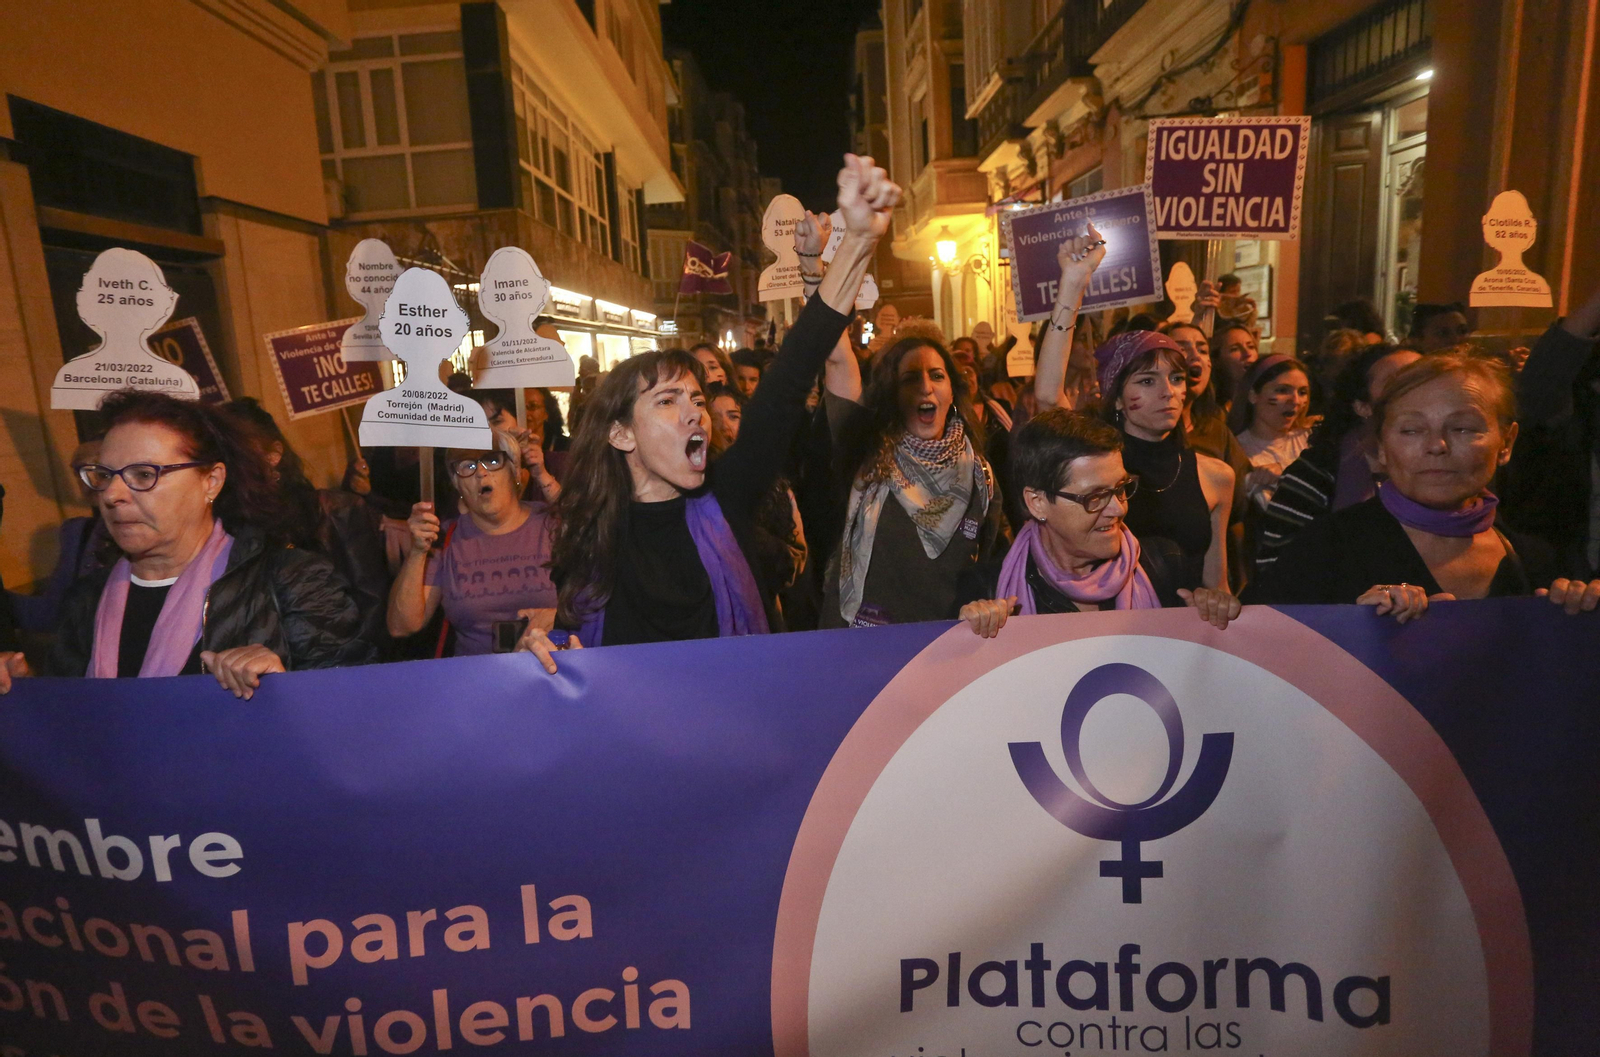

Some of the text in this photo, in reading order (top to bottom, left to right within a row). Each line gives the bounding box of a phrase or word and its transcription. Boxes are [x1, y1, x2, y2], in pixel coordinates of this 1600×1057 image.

[1160, 127, 1294, 161] IGUALDAD
[1201, 162, 1244, 194] SIN
[1054, 206, 1096, 223] Ante la
[1154, 196, 1285, 228] VIOLENCIA
[1489, 218, 1533, 228] Clotilde R.
[1019, 230, 1074, 246] Violencia
[1495, 230, 1528, 239] 82 años
[358, 262, 393, 271] Nombre
[98, 277, 153, 291] Iveth C.
[349, 273, 398, 283] no conocid
[494, 278, 529, 289] Imane
[361, 285, 371, 294] 44
[493, 291, 533, 302] 30 años
[1037, 281, 1058, 305] TE
[97, 294, 154, 307] 25 años
[398, 303, 448, 318] Esther
[305, 330, 337, 343] Ante la
[394, 322, 412, 336] 20
[415, 324, 453, 338] años
[501, 338, 538, 347] 01/11/2022
[280, 345, 322, 360] Violencia
[324, 342, 335, 351] de
[491, 349, 515, 357] Valencia
[524, 345, 551, 353] Alcántara
[490, 354, 554, 367] (Cáceres, Extremadura)
[94, 363, 153, 373] 21/03/2022
[63, 373, 183, 388] Barcelona (Cataluña)
[301, 384, 322, 405] TE
[321, 373, 375, 400] CALLES!
[402, 389, 448, 401] 20/08/2022
[386, 399, 423, 411] Torrejón
[427, 402, 465, 414] (Madrid)
[377, 410, 474, 424] Comunidad de Madrid
[287, 904, 491, 986] para
[520, 884, 593, 945] la
[899, 942, 1392, 1029] Plataforma
[88, 981, 182, 1039] de
[198, 994, 273, 1048] la
[290, 965, 692, 1056] violencia
[1016, 1015, 1243, 1052] contra las
